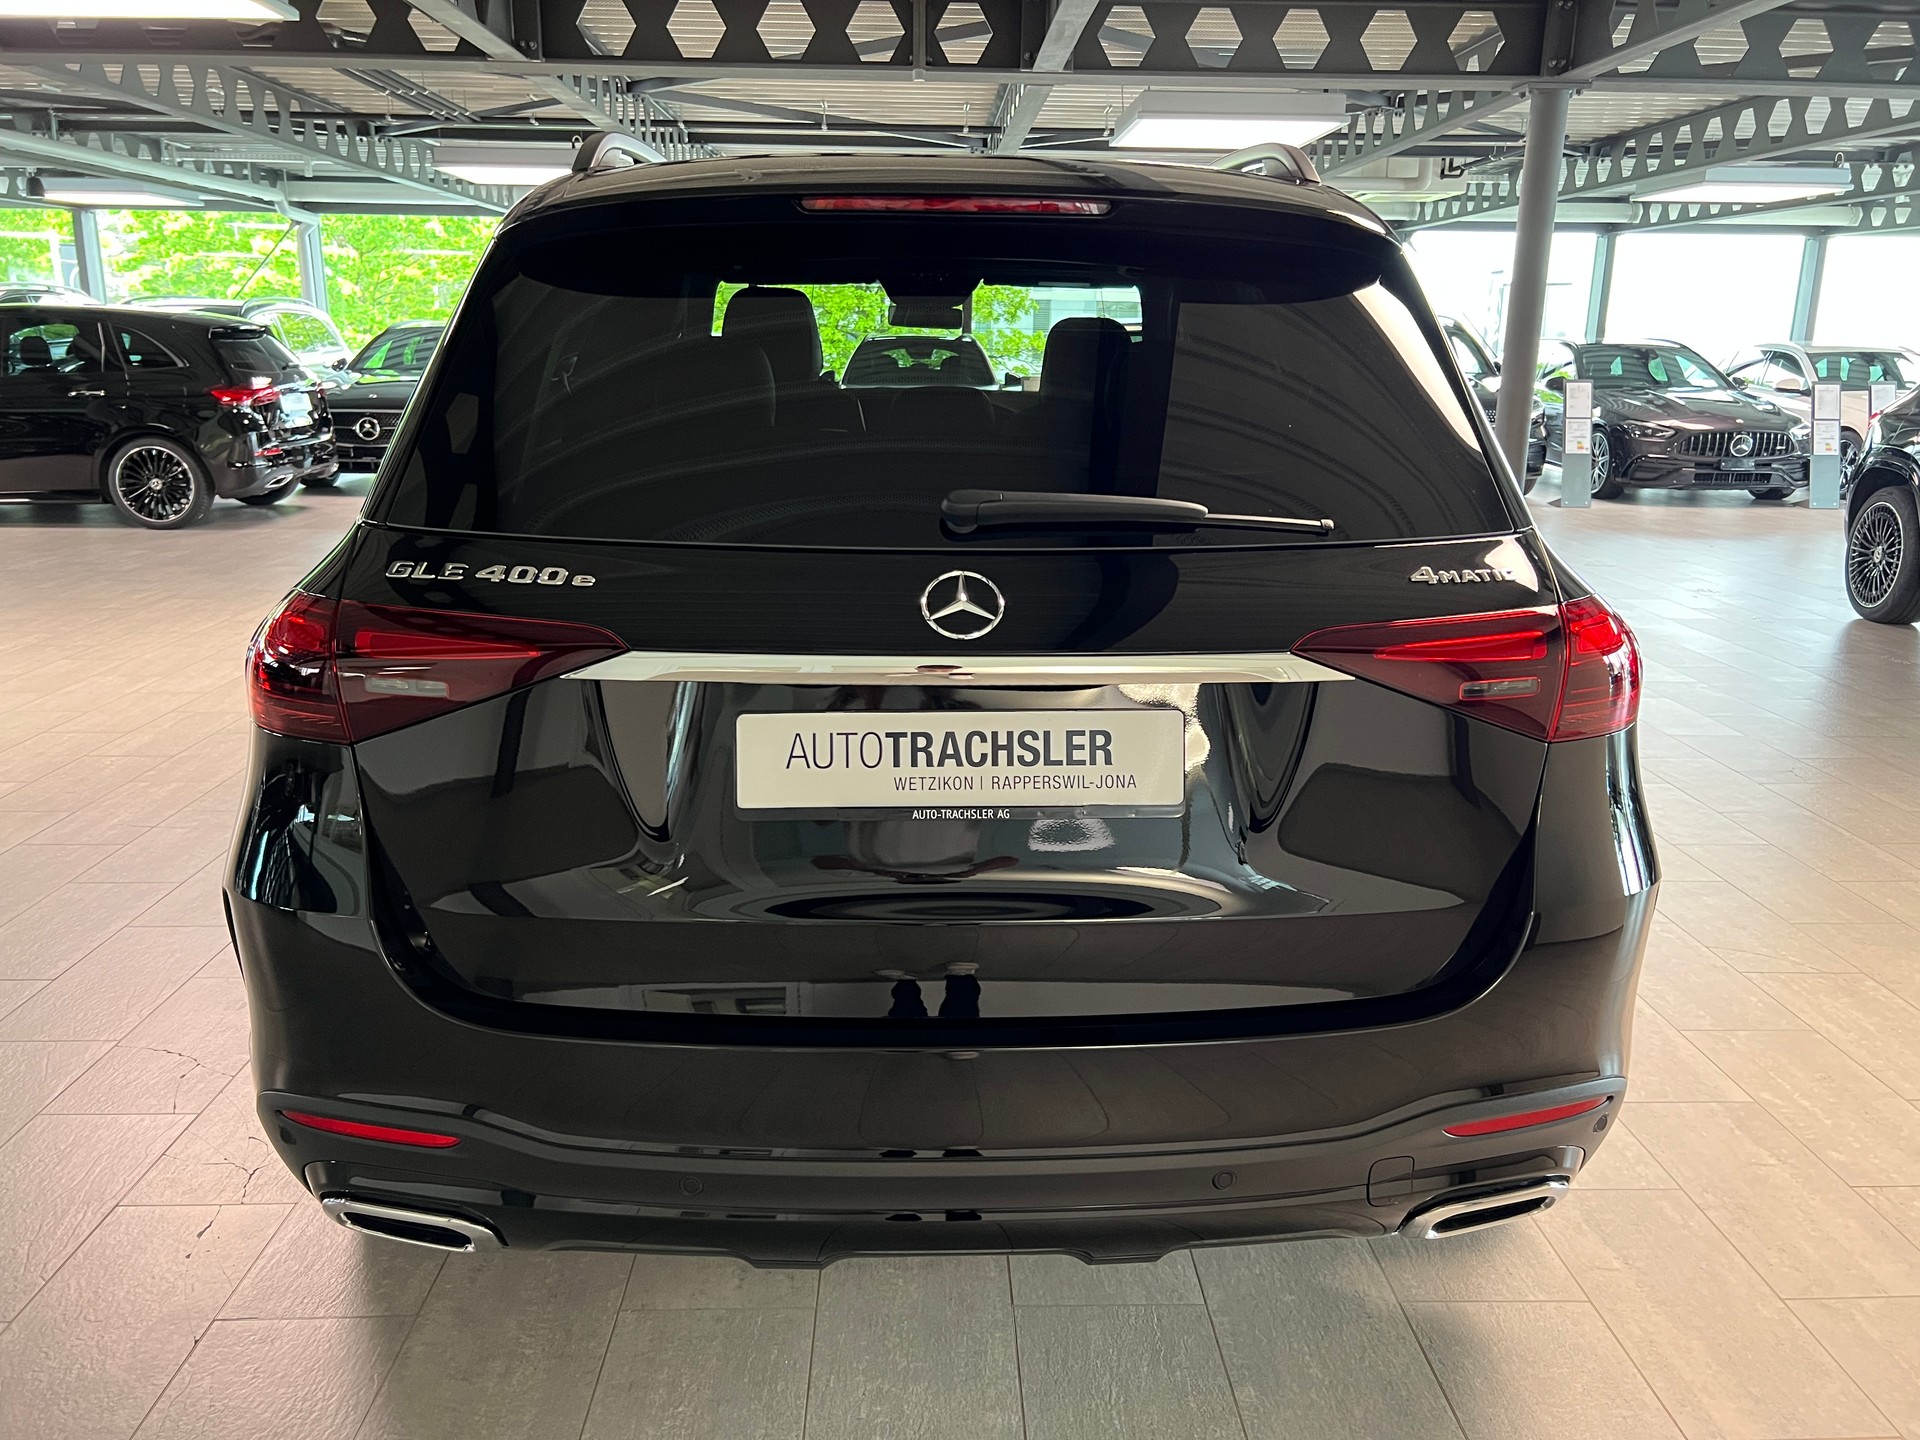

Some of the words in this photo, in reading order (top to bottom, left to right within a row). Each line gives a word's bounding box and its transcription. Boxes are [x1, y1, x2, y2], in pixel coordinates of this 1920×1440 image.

[385, 560, 469, 581] GLE
[475, 564, 569, 585] 400
[571, 574, 596, 587] e
[785, 729, 1114, 769] AUTOTRACHSLER
[893, 776, 974, 791] WETZIKON
[991, 775, 1137, 791] RAPPERSWIL-JONA
[912, 808, 994, 820] AUTO-TRACHSLER
[997, 808, 1011, 820] AG
